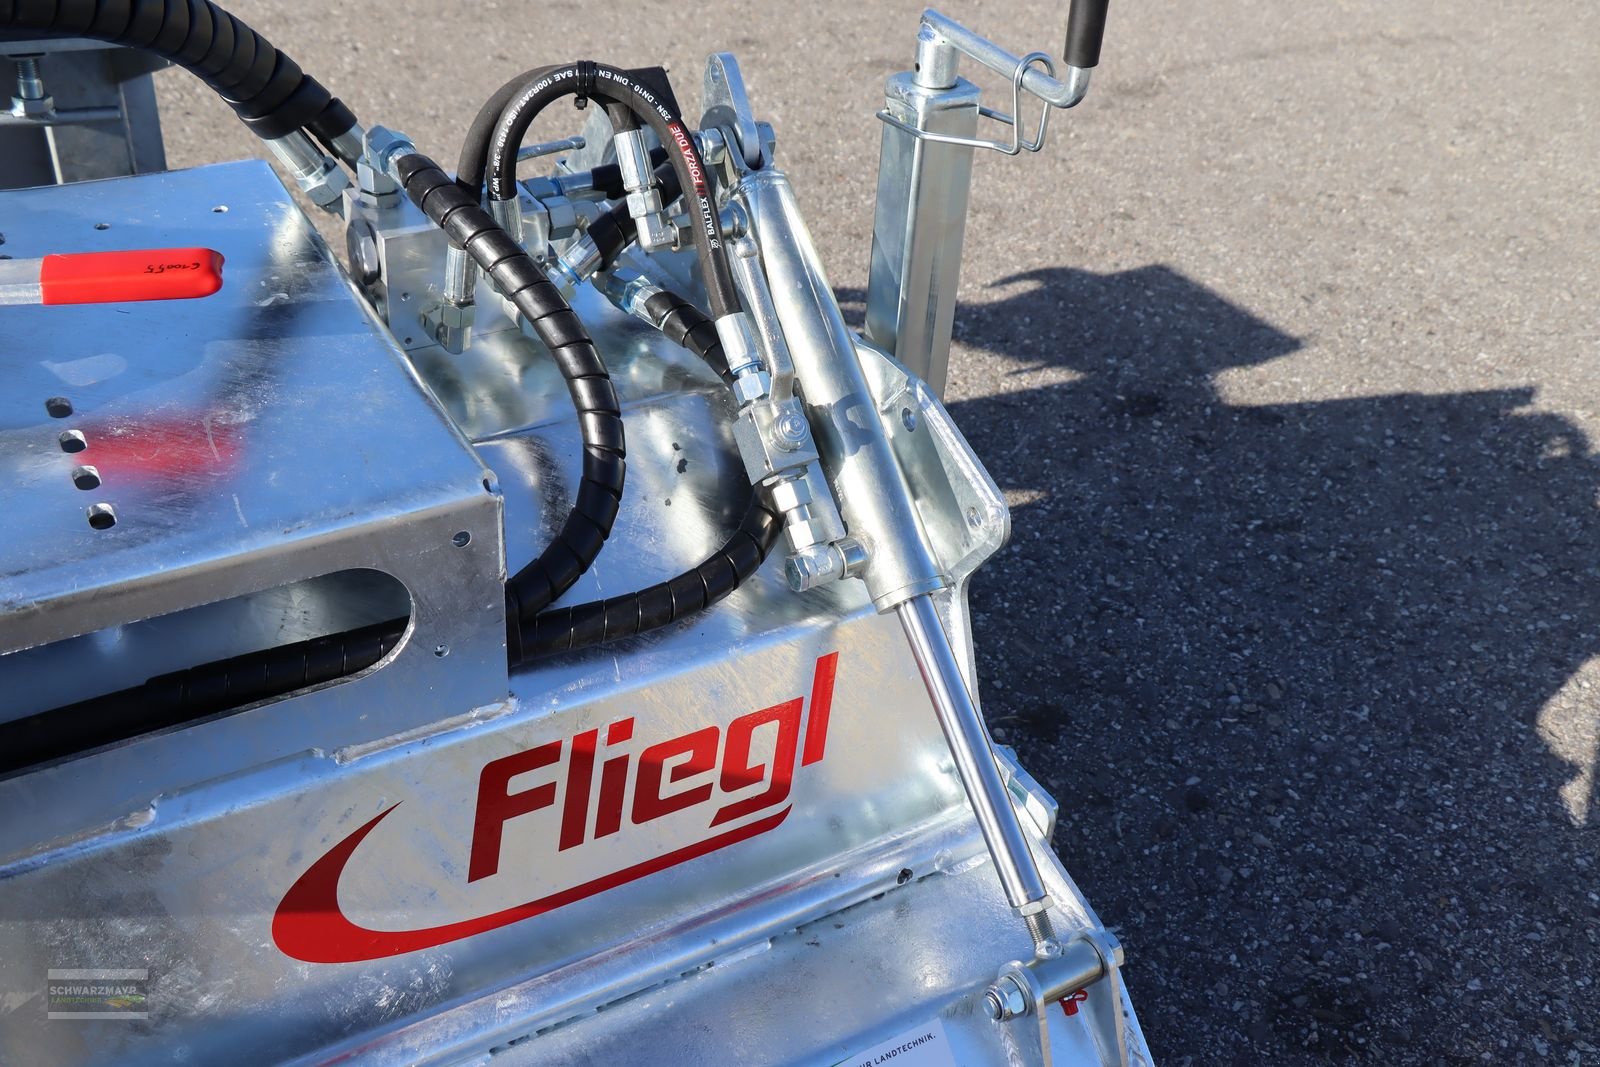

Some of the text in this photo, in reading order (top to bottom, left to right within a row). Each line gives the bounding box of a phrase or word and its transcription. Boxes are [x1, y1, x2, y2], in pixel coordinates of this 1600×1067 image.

[553, 69, 573, 82] SAE
[598, 69, 612, 79] EN
[613, 74, 629, 86] DIN
[519, 77, 553, 108] 100R2AT
[633, 85, 654, 104] DN10
[505, 110, 519, 126] ISO
[656, 104, 671, 121] 2SN
[671, 125, 689, 147] DUE
[683, 149, 703, 183] FORZA
[700, 197, 715, 235] BALFLEX
[468, 651, 839, 883] Fliegl
[874, 1032, 936, 1065] LANDTECHNIK.
